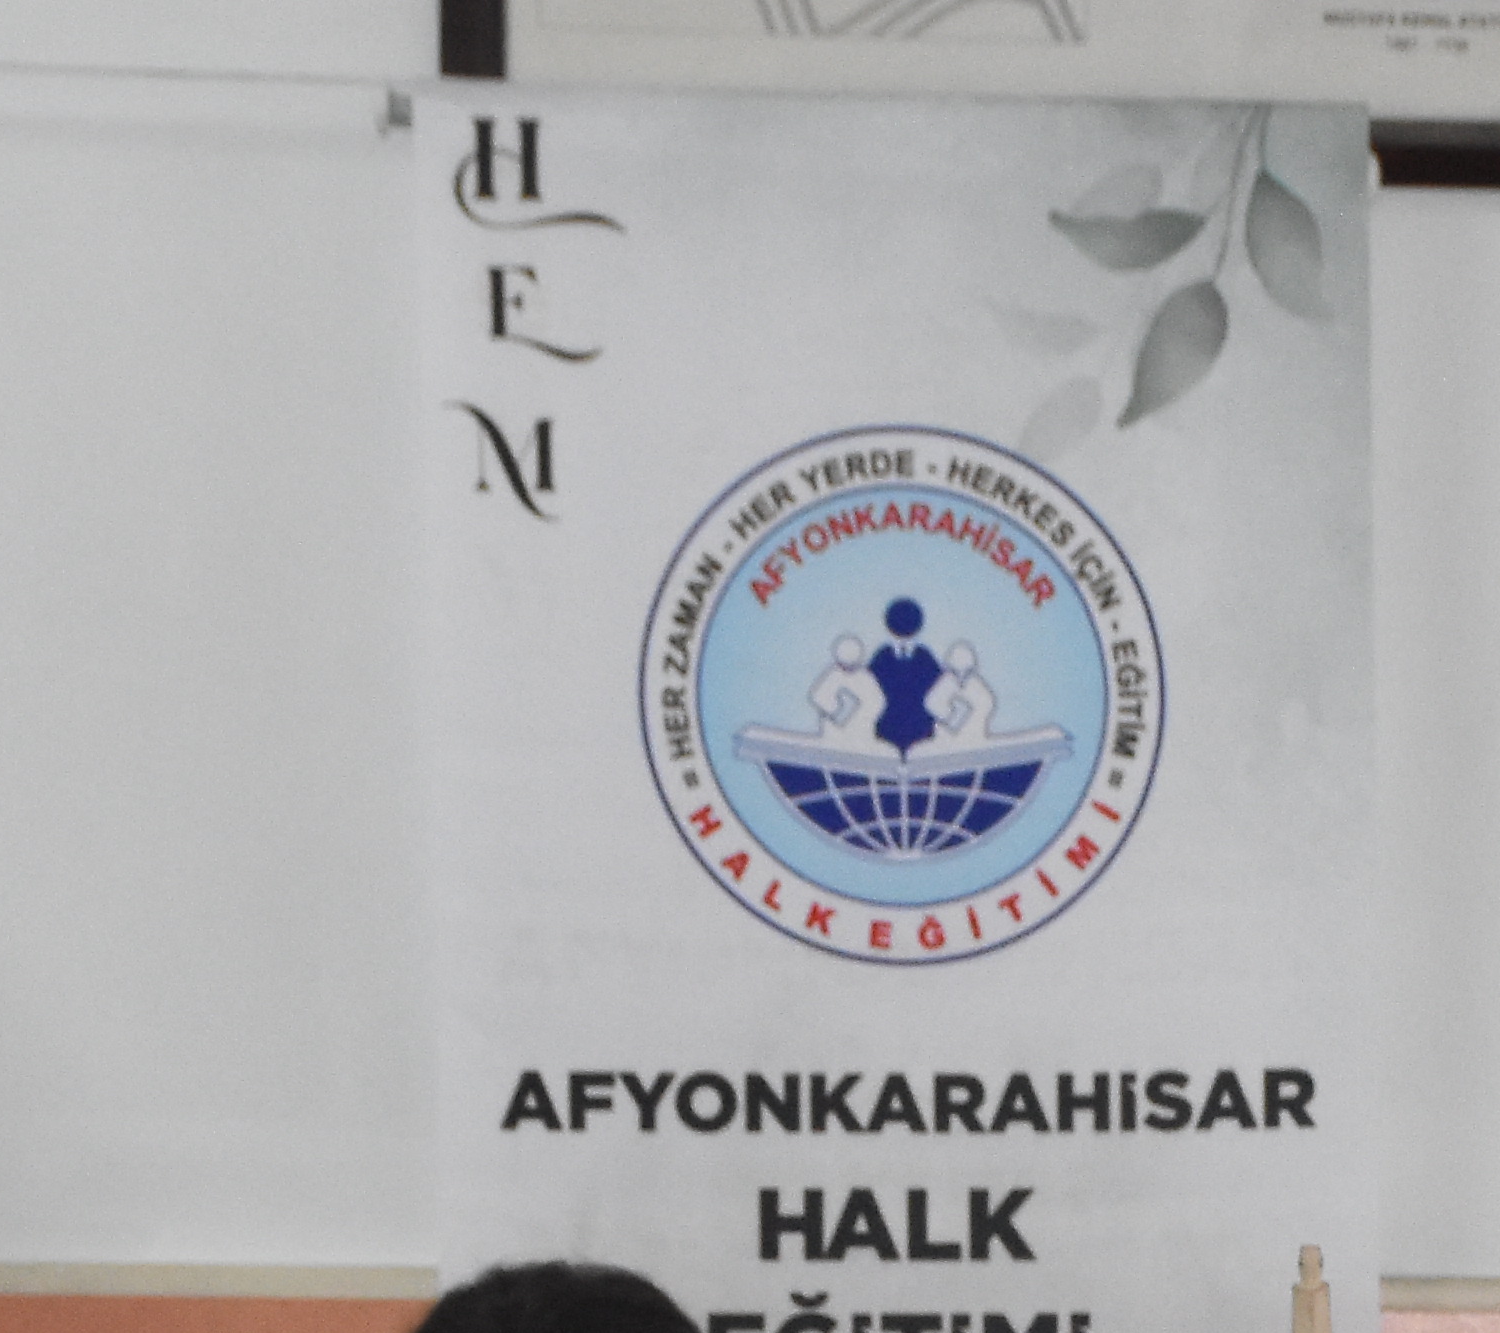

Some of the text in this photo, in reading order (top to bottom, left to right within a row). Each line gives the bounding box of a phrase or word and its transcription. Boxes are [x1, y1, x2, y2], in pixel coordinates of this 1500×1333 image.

[728, 479, 797, 541] HER
[799, 449, 914, 490] YERDE
[946, 455, 1075, 548] HERKES
[749, 502, 1056, 610] AFYONKARAHİSAR
[663, 553, 723, 676] ZAMAN
[661, 686, 693, 761] HER
[1111, 637, 1148, 760] EĞİTİM
[688, 799, 1121, 951] HALK EĞİTİMİ
[501, 1069, 1318, 1134] AFYONKARAHİSAR
[758, 1188, 1037, 1261] HALK
